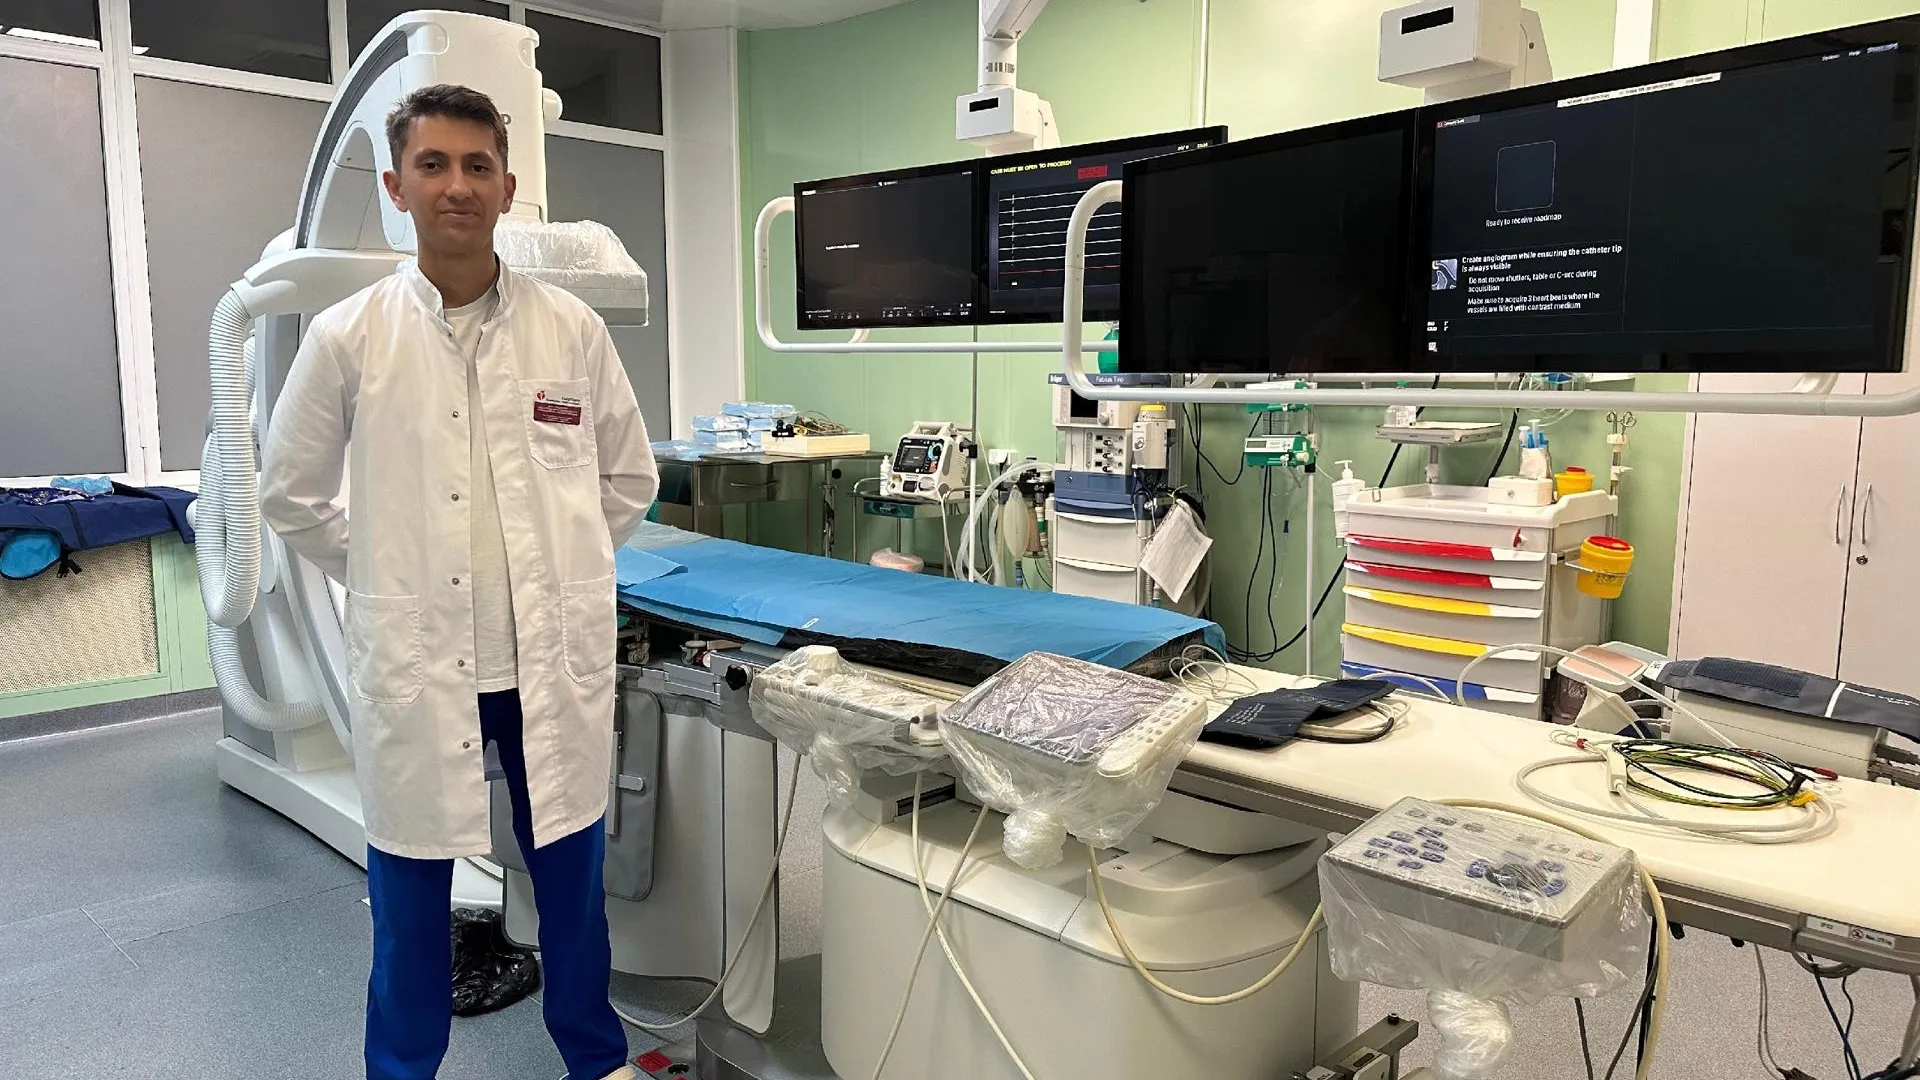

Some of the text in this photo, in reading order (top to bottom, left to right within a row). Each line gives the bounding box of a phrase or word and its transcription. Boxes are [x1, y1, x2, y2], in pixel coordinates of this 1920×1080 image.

[1485, 219, 1503, 227] Ready
[1512, 216, 1532, 225] receive
[1534, 213, 1562, 222] roadmap
[1462, 244, 1623, 264] Create angiogram while ensuring the catheter tip
[1468, 264, 1489, 272] always
[1490, 262, 1511, 270] visible
[1478, 276, 1487, 284] not
[1505, 274, 1532, 282] shutters,
[1532, 272, 1548, 280] table
[1576, 269, 1597, 278] during
[1468, 285, 1500, 293] acquisition
[1467, 297, 1483, 305] Make
[1504, 295, 1528, 304] acquire
[1532, 294, 1549, 302] heart
[1549, 293, 1568, 301] beats
[1568, 292, 1588, 300] where
[1588, 291, 1600, 299] the
[1467, 306, 1488, 314] vessels
[1498, 304, 1514, 312] filled
[1527, 303, 1553, 311] contrast
[1553, 301, 1581, 310] medium
